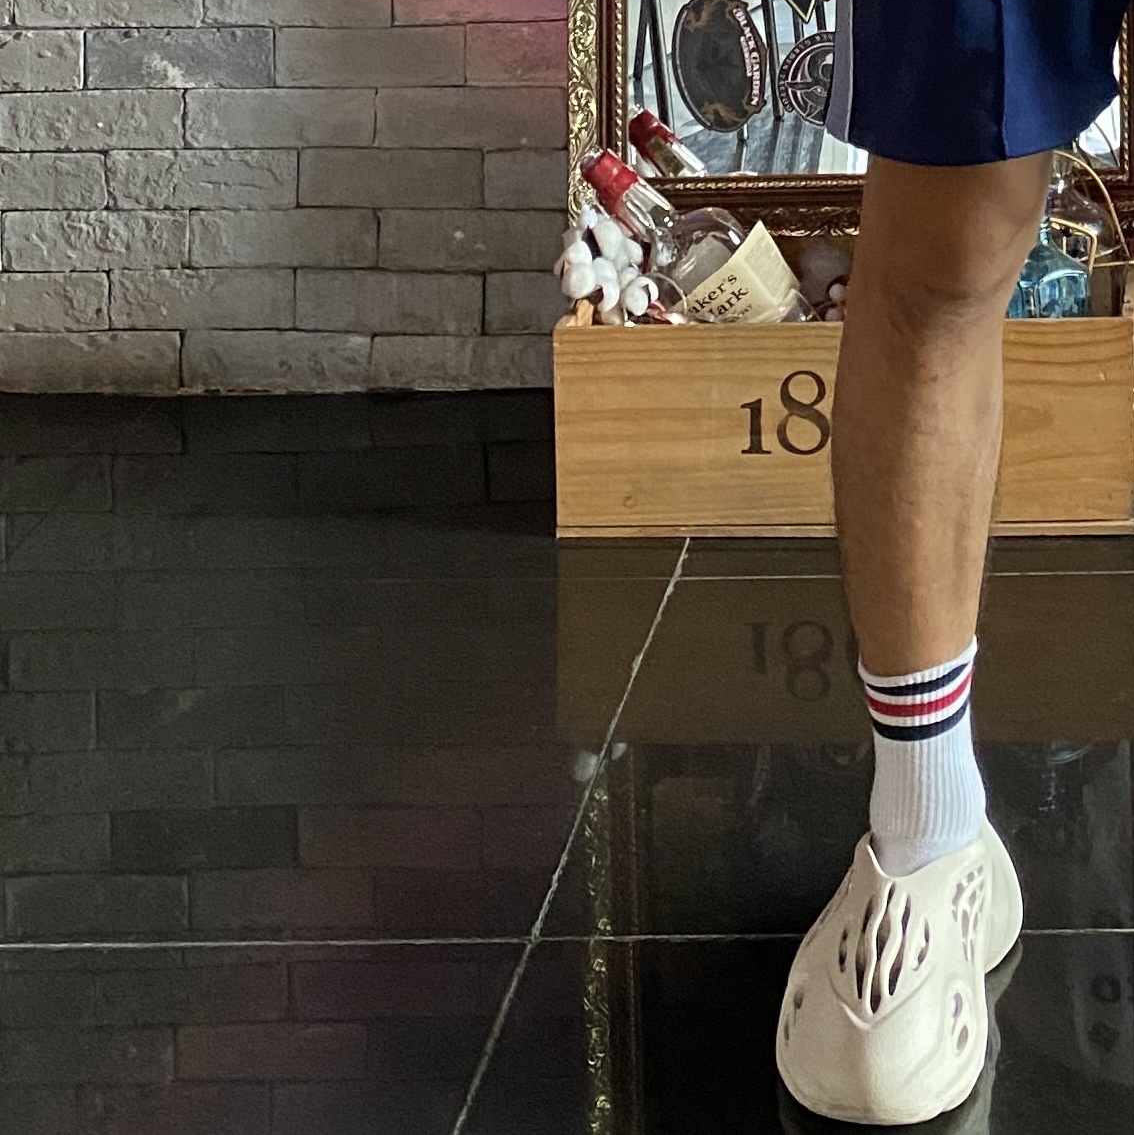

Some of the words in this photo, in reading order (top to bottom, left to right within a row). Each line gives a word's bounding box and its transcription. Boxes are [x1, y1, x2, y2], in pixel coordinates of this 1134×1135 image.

[750, 52, 761, 106] GARDEN
[688, 274, 737, 313] aker's
[740, 370, 831, 456] 18
